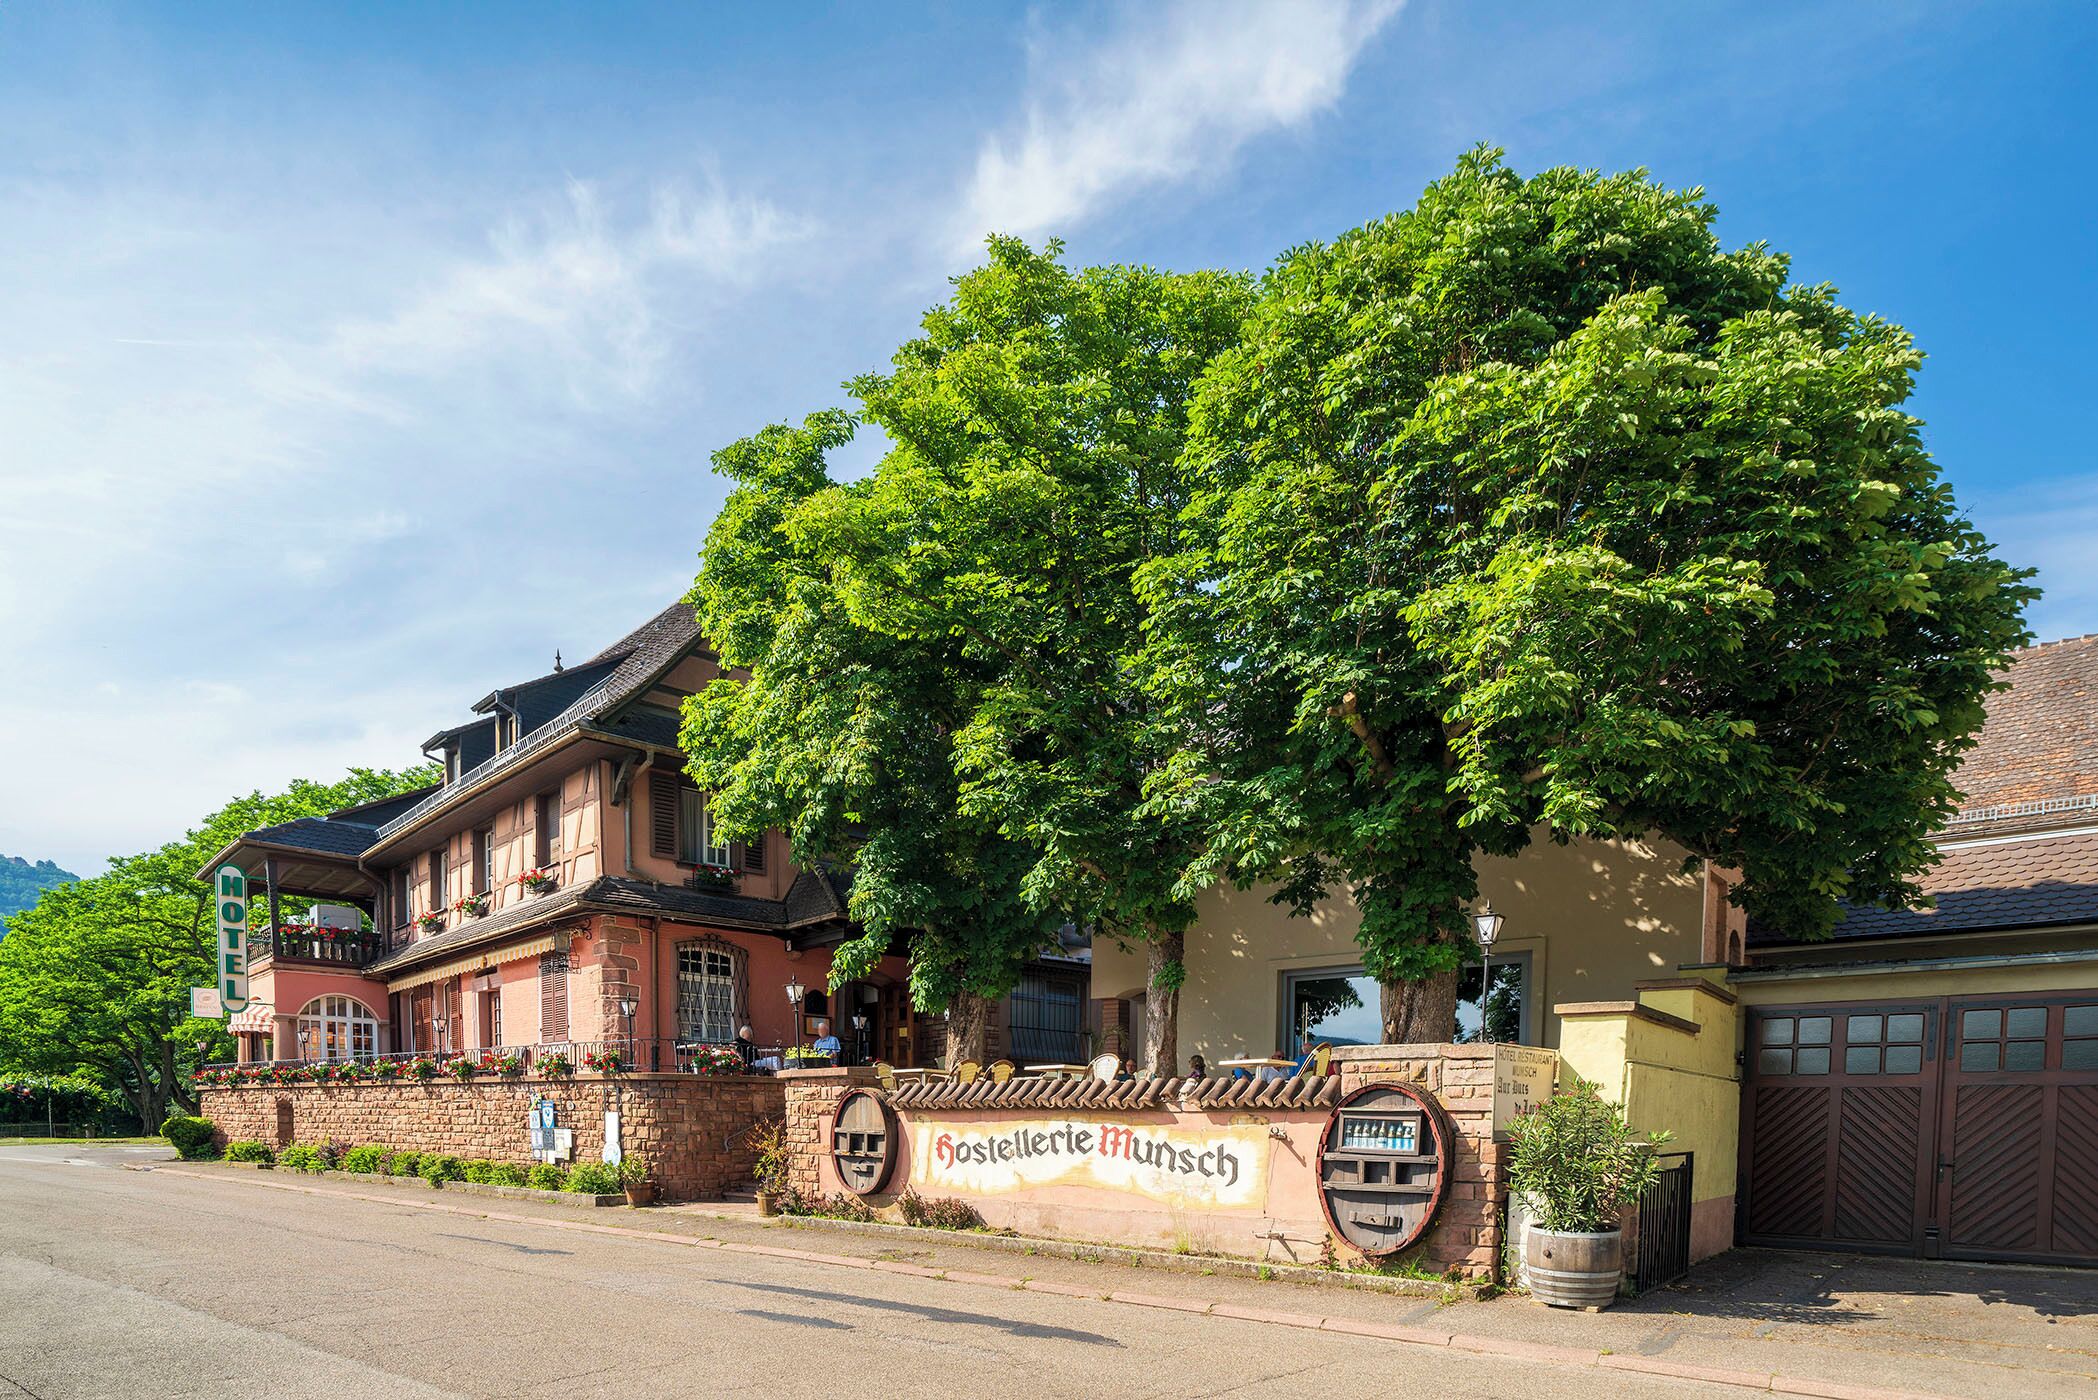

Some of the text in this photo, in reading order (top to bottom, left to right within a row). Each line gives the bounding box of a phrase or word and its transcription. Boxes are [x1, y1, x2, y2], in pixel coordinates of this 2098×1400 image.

[221, 874, 245, 1001] HOTEL
[1518, 1051, 1552, 1065] RESTAURANT
[936, 1124, 1239, 1187] Hostellerie Munsch
